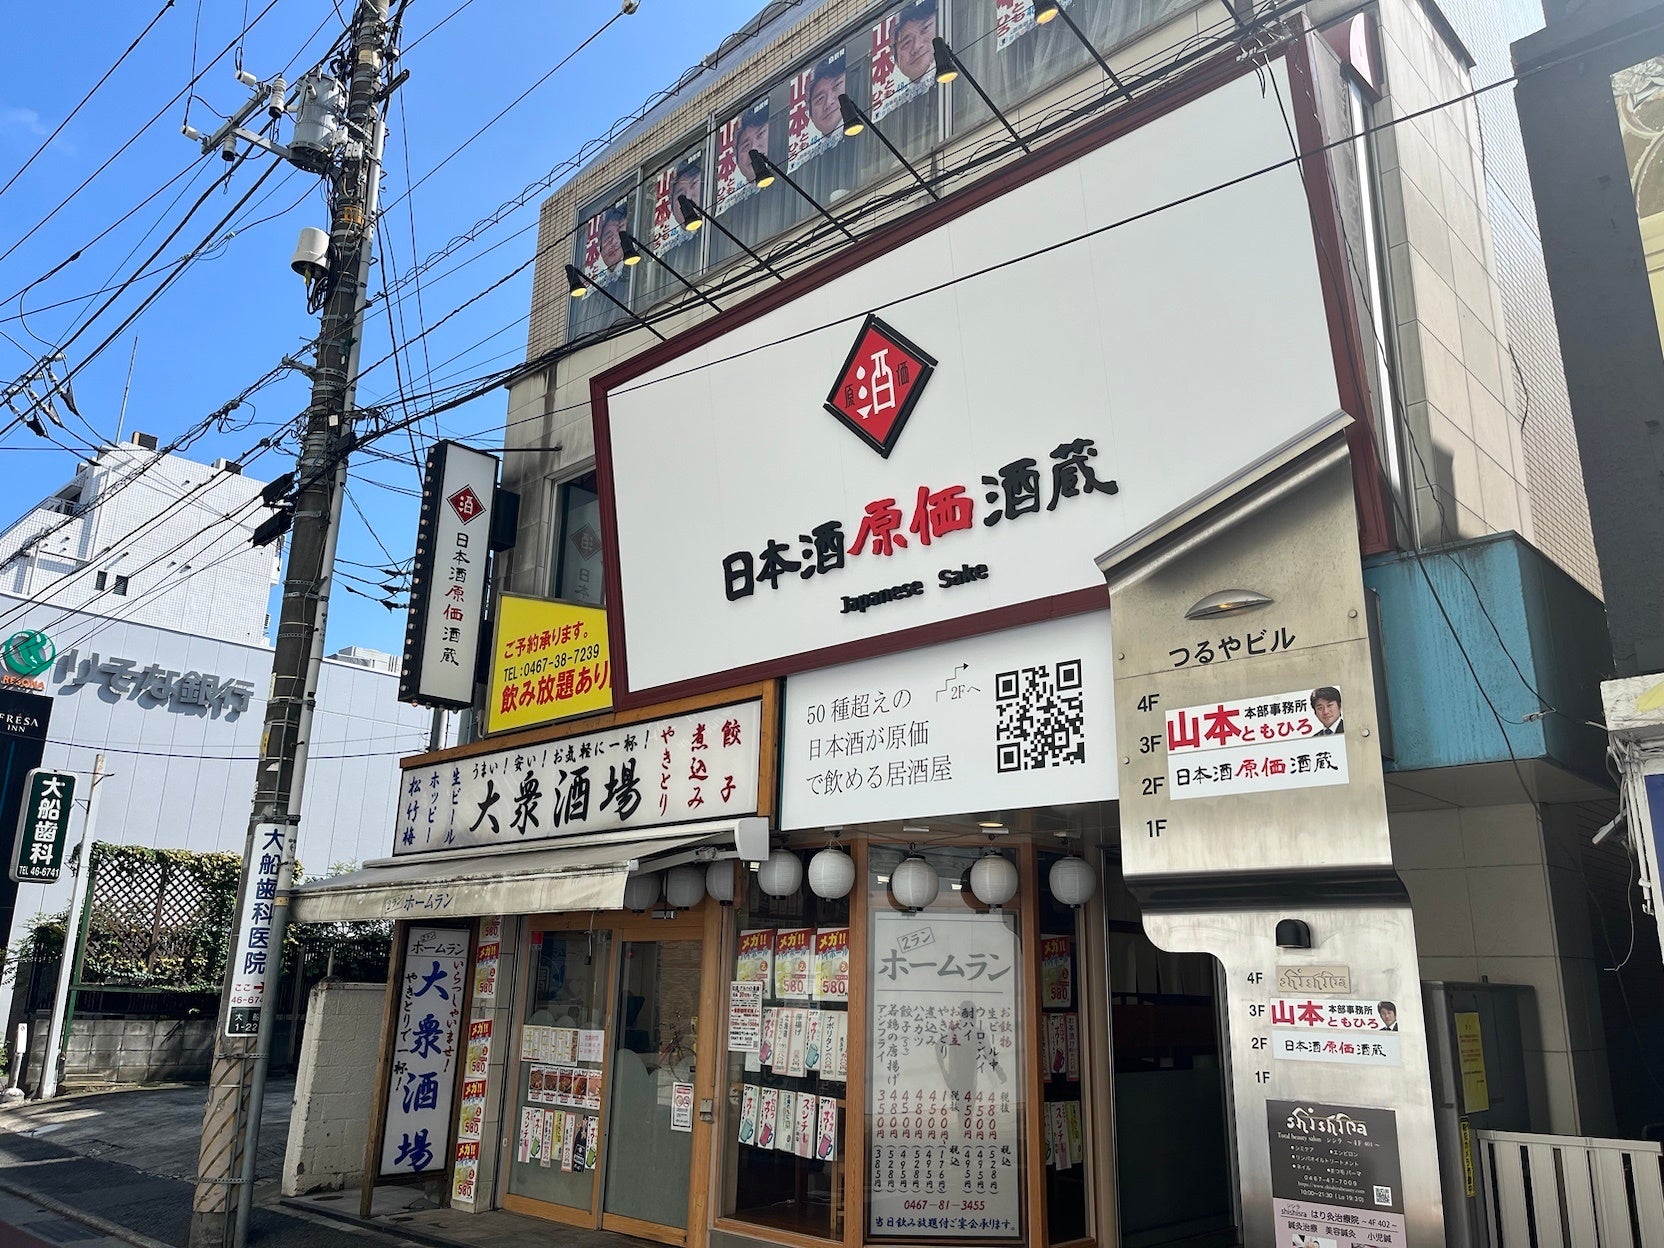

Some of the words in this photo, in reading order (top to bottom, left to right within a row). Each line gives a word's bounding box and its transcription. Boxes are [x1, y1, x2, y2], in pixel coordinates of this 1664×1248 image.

[856, 348, 896, 419] 酒
[458, 495, 474, 516] 酒
[722, 437, 1118, 602] 日本酒原価酒蔵
[440, 532, 470, 667] 日本酒原価酒蔵
[840, 579, 924, 614] Japanese
[938, 562, 989, 589] Sake
[503, 621, 589, 660] ご予約承ります。
[1169, 626, 1296, 667] つるやビル
[66, 648, 255, 713] りそな銀行
[1137, 693, 1161, 713] 4F
[1244, 699, 1308, 720] 本部事務所
[7, 724, 26, 733] INN
[808, 719, 930, 761] 日本酒が原価
[1139, 734, 1163, 754] 3F
[1167, 704, 1242, 751] 山本
[1242, 718, 1313, 742] ともひろ
[658, 726, 676, 817] やきとり
[687, 723, 709, 810] 煮込み
[721, 719, 743, 803] 餃子
[806, 754, 953, 796] で飲める居酒屋
[1176, 751, 1339, 787] 日本酒原価酒蔵
[443, 767, 461, 845] 生ビール
[469, 756, 643, 835] 大衆酒場
[1142, 776, 1165, 797] 2F
[29, 776, 63, 864] 大船歯科
[402, 775, 422, 847] 松竹梅
[426, 774, 441, 844] ホッピー
[1146, 819, 1168, 838] 1F
[19, 866, 29, 876] TEL
[30, 866, 60, 878] 46-6741
[243, 828, 284, 975] 大船歯科医院
[404, 894, 453, 912] ホームラン
[411, 941, 465, 956] ホームラン
[901, 931, 931, 950] 2ラン
[878, 949, 1012, 982] ホームラン
[1247, 972, 1263, 984] 4F
[913, 1006, 924, 1046] ハムカツ
[925, 1006, 938, 1046] 煮込み
[962, 1007, 974, 1041] 酎ハイ
[1000, 1007, 1013, 1048] お飲物
[1249, 1004, 1265, 1017] 3F
[1271, 1000, 1325, 1027] 山本
[1327, 1016, 1379, 1029] ともひろ
[1328, 1005, 1373, 1016] 本部事務所
[876, 1004, 887, 1063] アジフライ
[886, 1004, 900, 1086] 若鶏の唐揚げ
[938, 1006, 949, 1058] やきとり
[976, 1007, 986, 1074] ウーロンハイ
[1251, 1037, 1268, 1050] 2F
[1285, 1040, 1387, 1057] 日本酒原価酒蔵
[394, 960, 450, 1173] 大衆酒場
[1255, 1071, 1271, 1084] 1F
[876, 1089, 886, 1139] 350円
[889, 1089, 898, 1139] 480円
[902, 1089, 910, 1139] 450円
[914, 1089, 923, 1139] 480円
[928, 1089, 936, 1140] 450円
[964, 1090, 973, 1140] 450円
[976, 1091, 985, 1140] 450円
[987, 1091, 997, 1140] 480円
[1310, 1209, 1360, 1226] はり灸治療院
